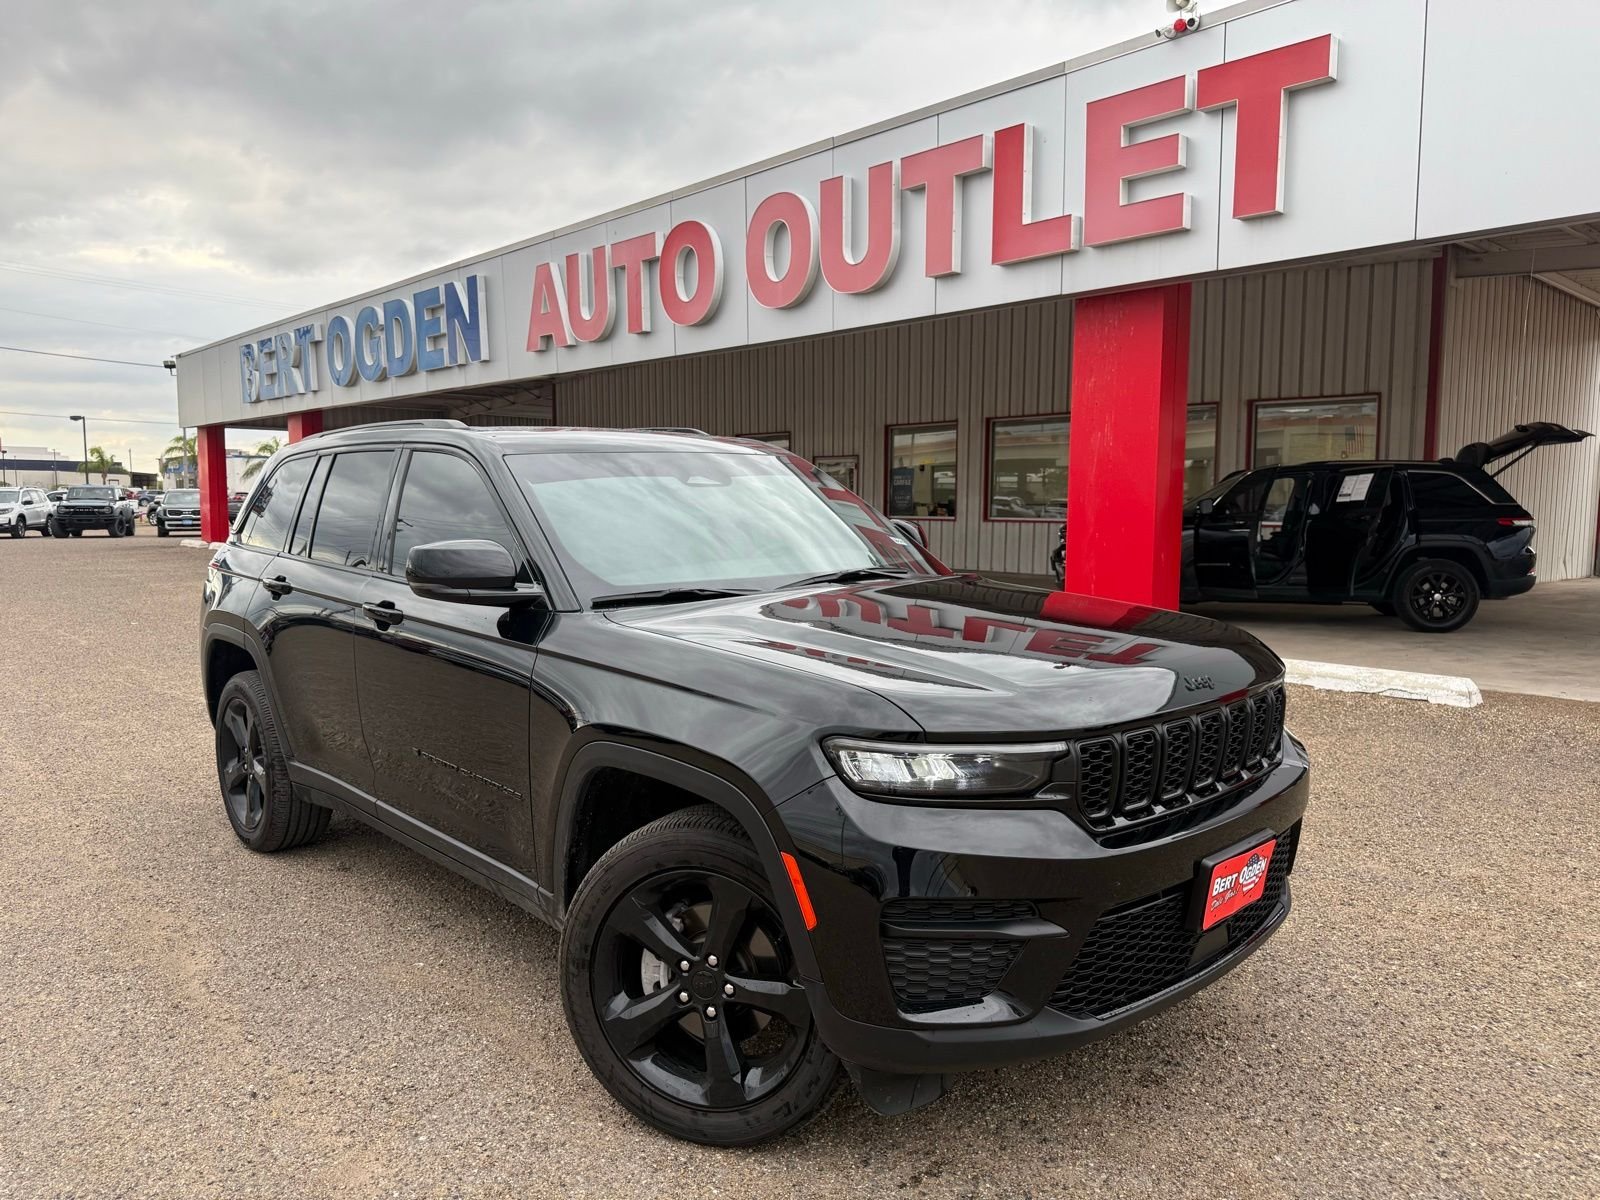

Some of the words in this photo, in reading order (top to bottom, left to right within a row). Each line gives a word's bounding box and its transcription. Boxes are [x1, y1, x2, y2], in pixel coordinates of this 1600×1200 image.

[239, 323, 323, 403] BERT
[327, 274, 490, 388] OGDEN
[526, 220, 724, 352] AUTO
[746, 33, 1338, 310] OUTLET
[1184, 676, 1215, 691] Jeep
[1212, 873, 1239, 897] BERT
[1239, 857, 1268, 884] OGDEN
